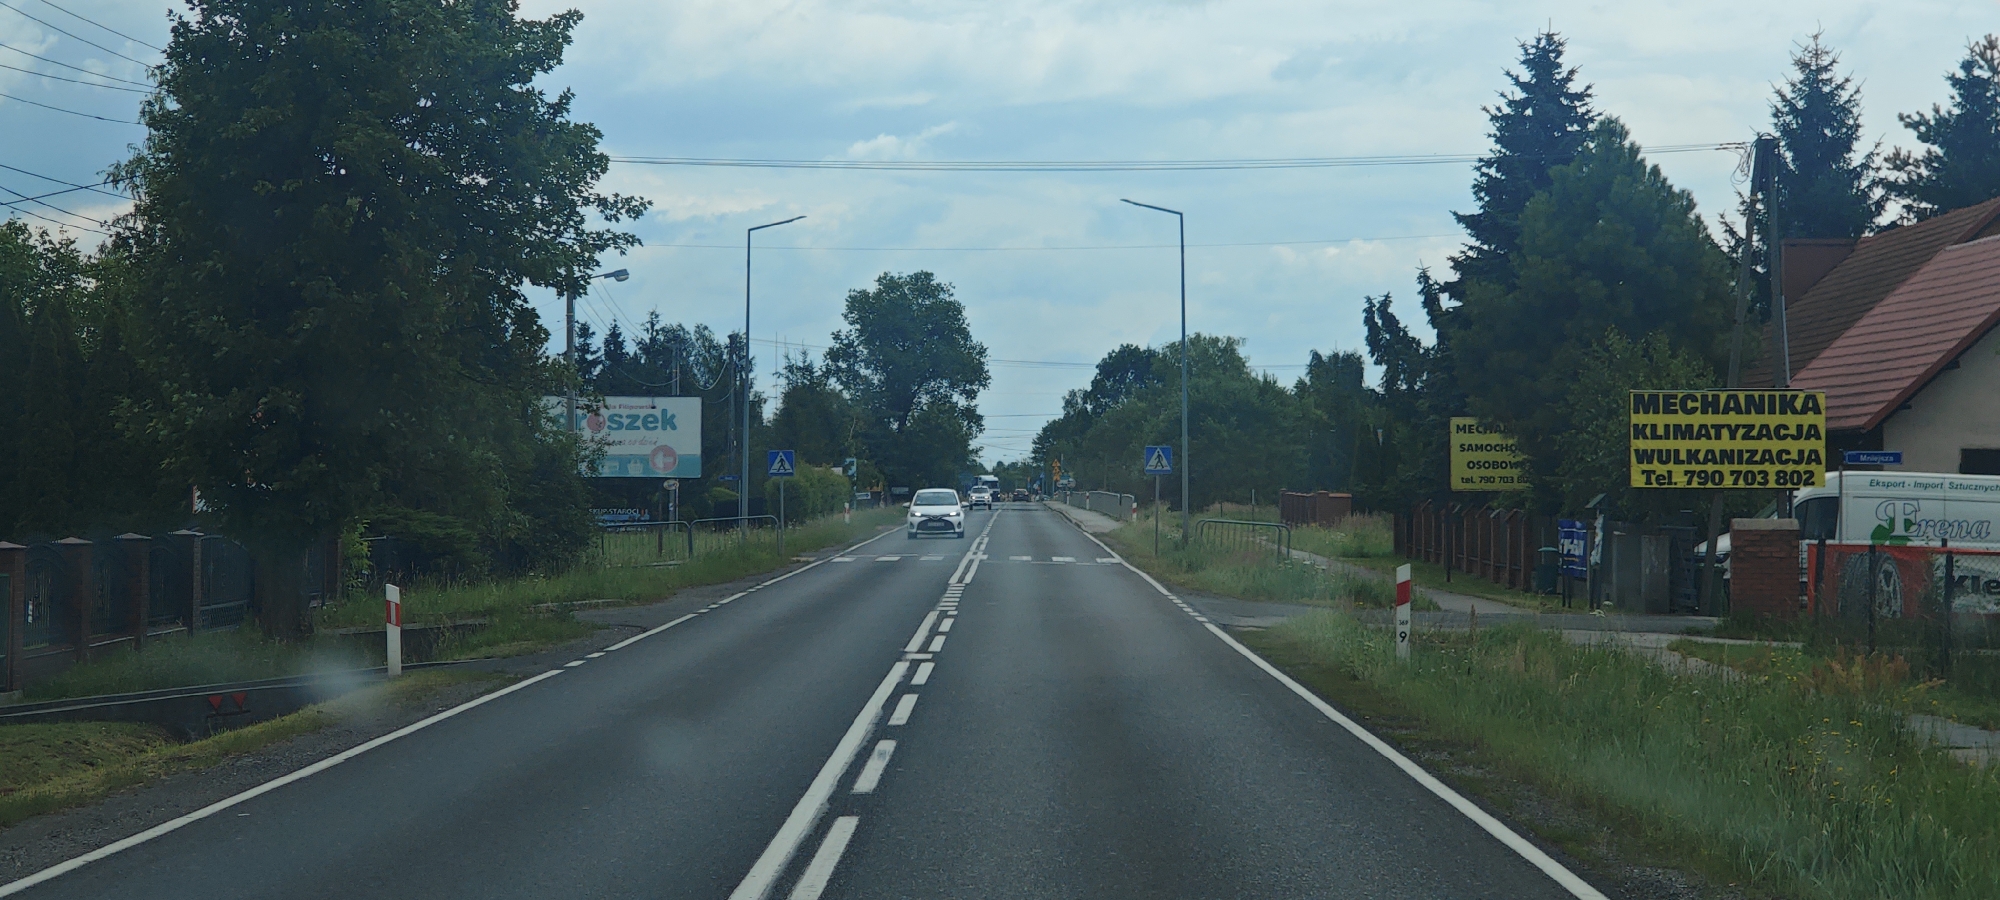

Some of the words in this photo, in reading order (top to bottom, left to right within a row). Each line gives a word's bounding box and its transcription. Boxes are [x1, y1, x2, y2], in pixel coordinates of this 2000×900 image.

[1632, 393, 1822, 415] MECHANIKA
[1455, 424, 1508, 434] MECA
[1632, 423, 1822, 441] KLIMATYZACJA
[1459, 443, 1518, 453] SAMOCHO
[1633, 448, 1822, 465] WULKANIZACJA
[1859, 454, 1894, 464] Mniejsza
[1478, 476, 1496, 484] 790
[1498, 476, 1514, 484] 703
[1641, 470, 1677, 486] Tel.
[1684, 470, 1725, 486] 790
[1729, 470, 1769, 486] 703
[1774, 470, 1816, 486] 802
[1869, 478, 1906, 489] Eksport
[1913, 480, 1944, 490] Import
[1948, 481, 2000, 493] Sztucznych
[1399, 631, 1407, 643] 9
